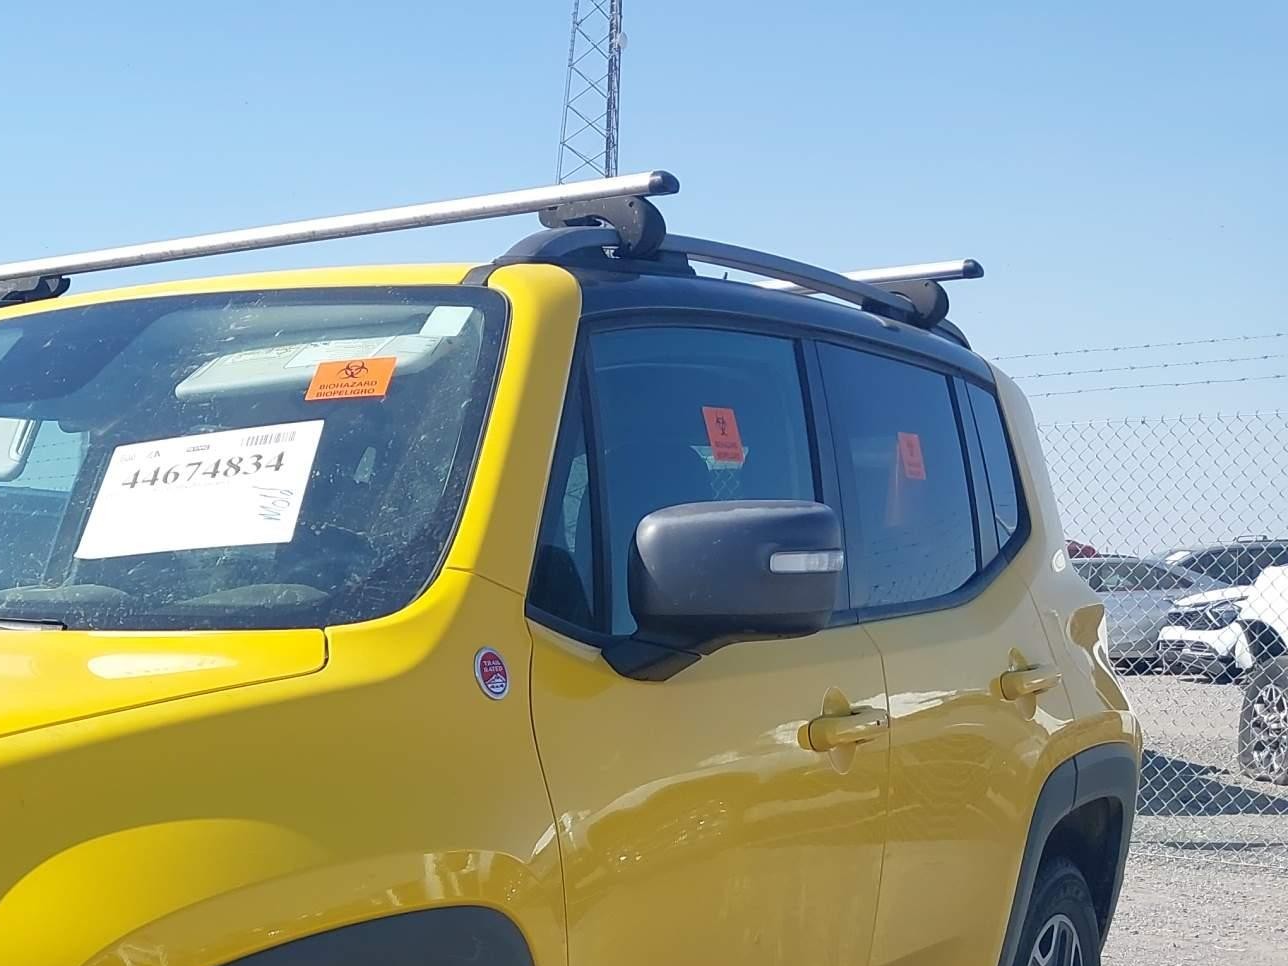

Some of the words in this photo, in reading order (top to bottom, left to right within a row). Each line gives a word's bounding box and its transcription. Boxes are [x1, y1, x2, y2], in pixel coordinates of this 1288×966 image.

[319, 380, 377, 390] BIOHAZARD
[316, 388, 375, 397] BIOPELIGRO
[121, 451, 285, 489] 44674834
